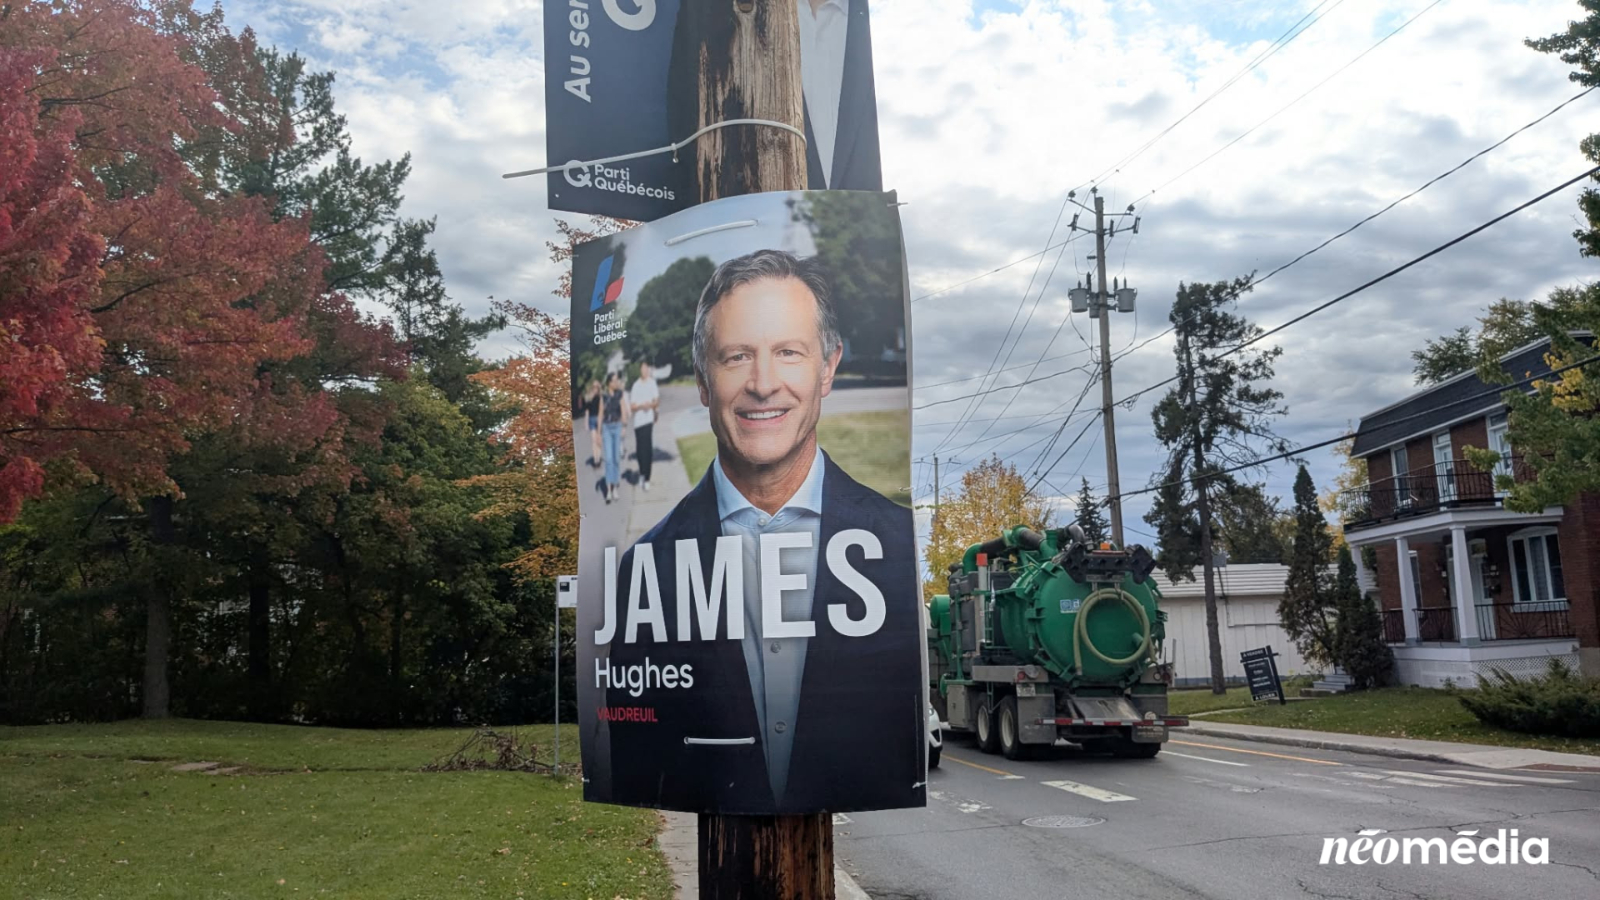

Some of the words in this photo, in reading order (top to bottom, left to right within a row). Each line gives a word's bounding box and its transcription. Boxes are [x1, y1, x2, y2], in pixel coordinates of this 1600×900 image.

[564, 55, 591, 103] Au
[594, 164, 630, 181] Parti
[594, 176, 676, 201] Québécois
[594, 309, 615, 324] Parti
[594, 318, 623, 335] Libéral
[593, 329, 628, 345] Québec
[594, 528, 887, 645] JAMES
[595, 656, 694, 697] Hughes
[597, 706, 658, 722] VAUDREUIL
